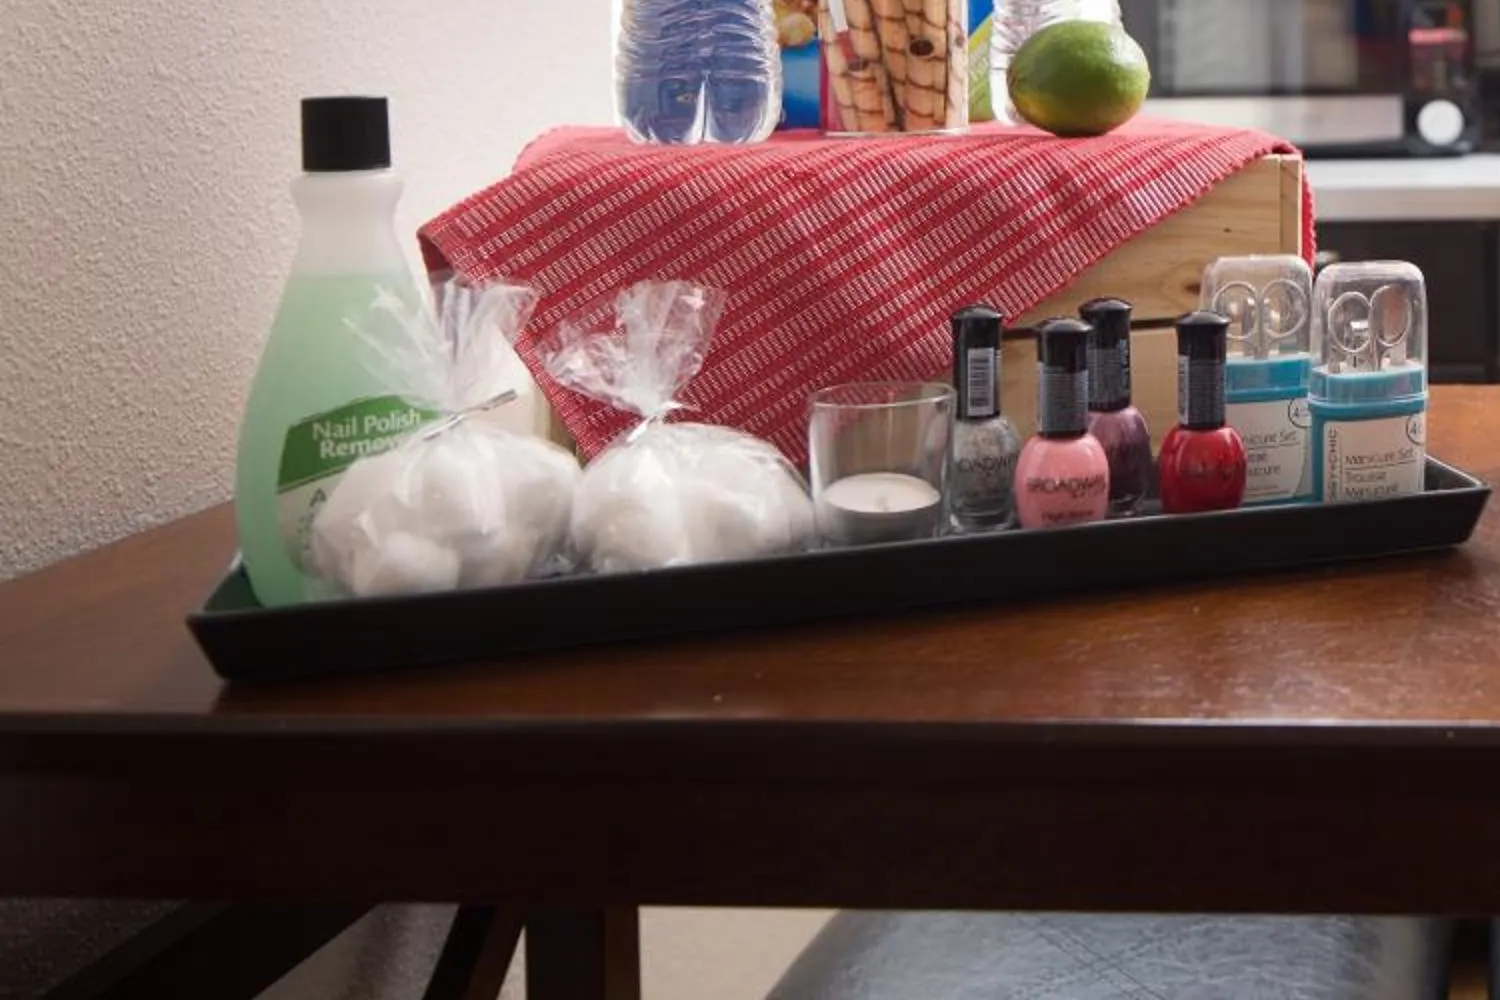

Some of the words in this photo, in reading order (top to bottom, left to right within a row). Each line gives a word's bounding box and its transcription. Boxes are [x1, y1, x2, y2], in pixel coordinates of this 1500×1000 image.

[312, 415, 358, 442] Nail
[363, 407, 421, 435] Polish
[319, 436, 405, 460] Remov
